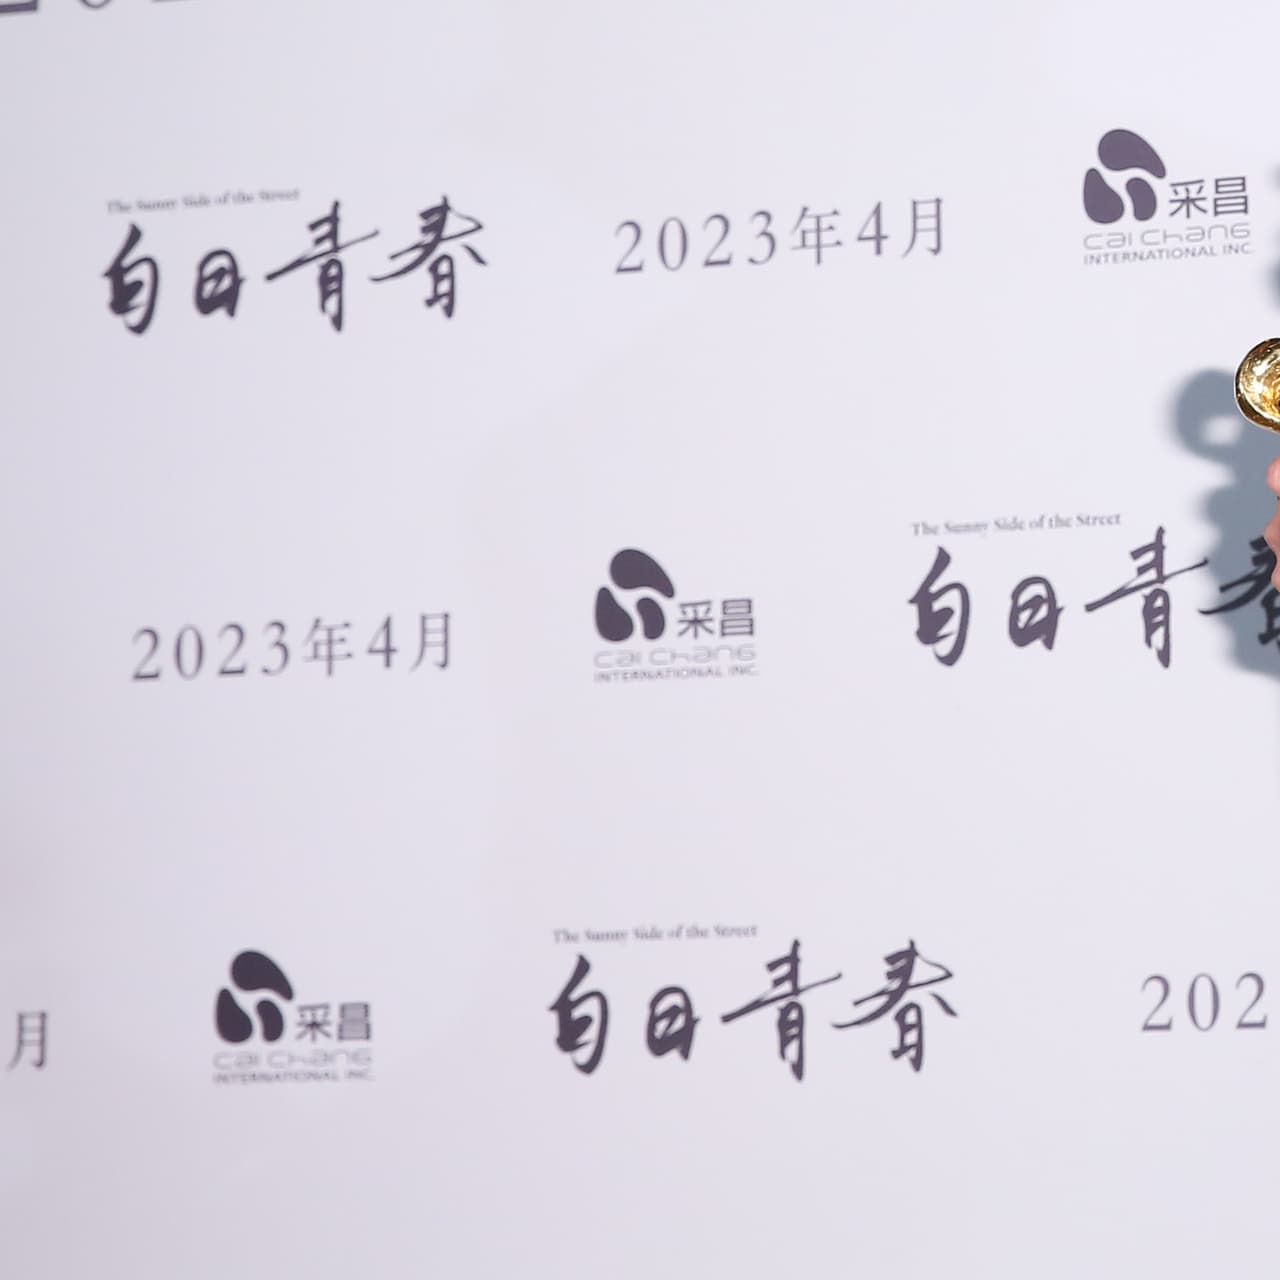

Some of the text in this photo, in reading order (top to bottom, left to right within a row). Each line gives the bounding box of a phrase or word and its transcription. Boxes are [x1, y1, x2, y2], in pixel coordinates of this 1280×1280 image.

[1168, 176, 1249, 219] 采昌
[614, 197, 945, 276] 2023年4月
[1083, 245, 1218, 266] INTERNATIONAL
[102, 195, 488, 336] 白日青春
[677, 598, 755, 640] 采昌
[131, 611, 452, 684] 2023年4月
[594, 668, 723, 684] INTERNATIONAL
[296, 1002, 372, 1044] 采昌
[548, 937, 958, 1083] 白日青春
[7, 1010, 49, 1072] 月
